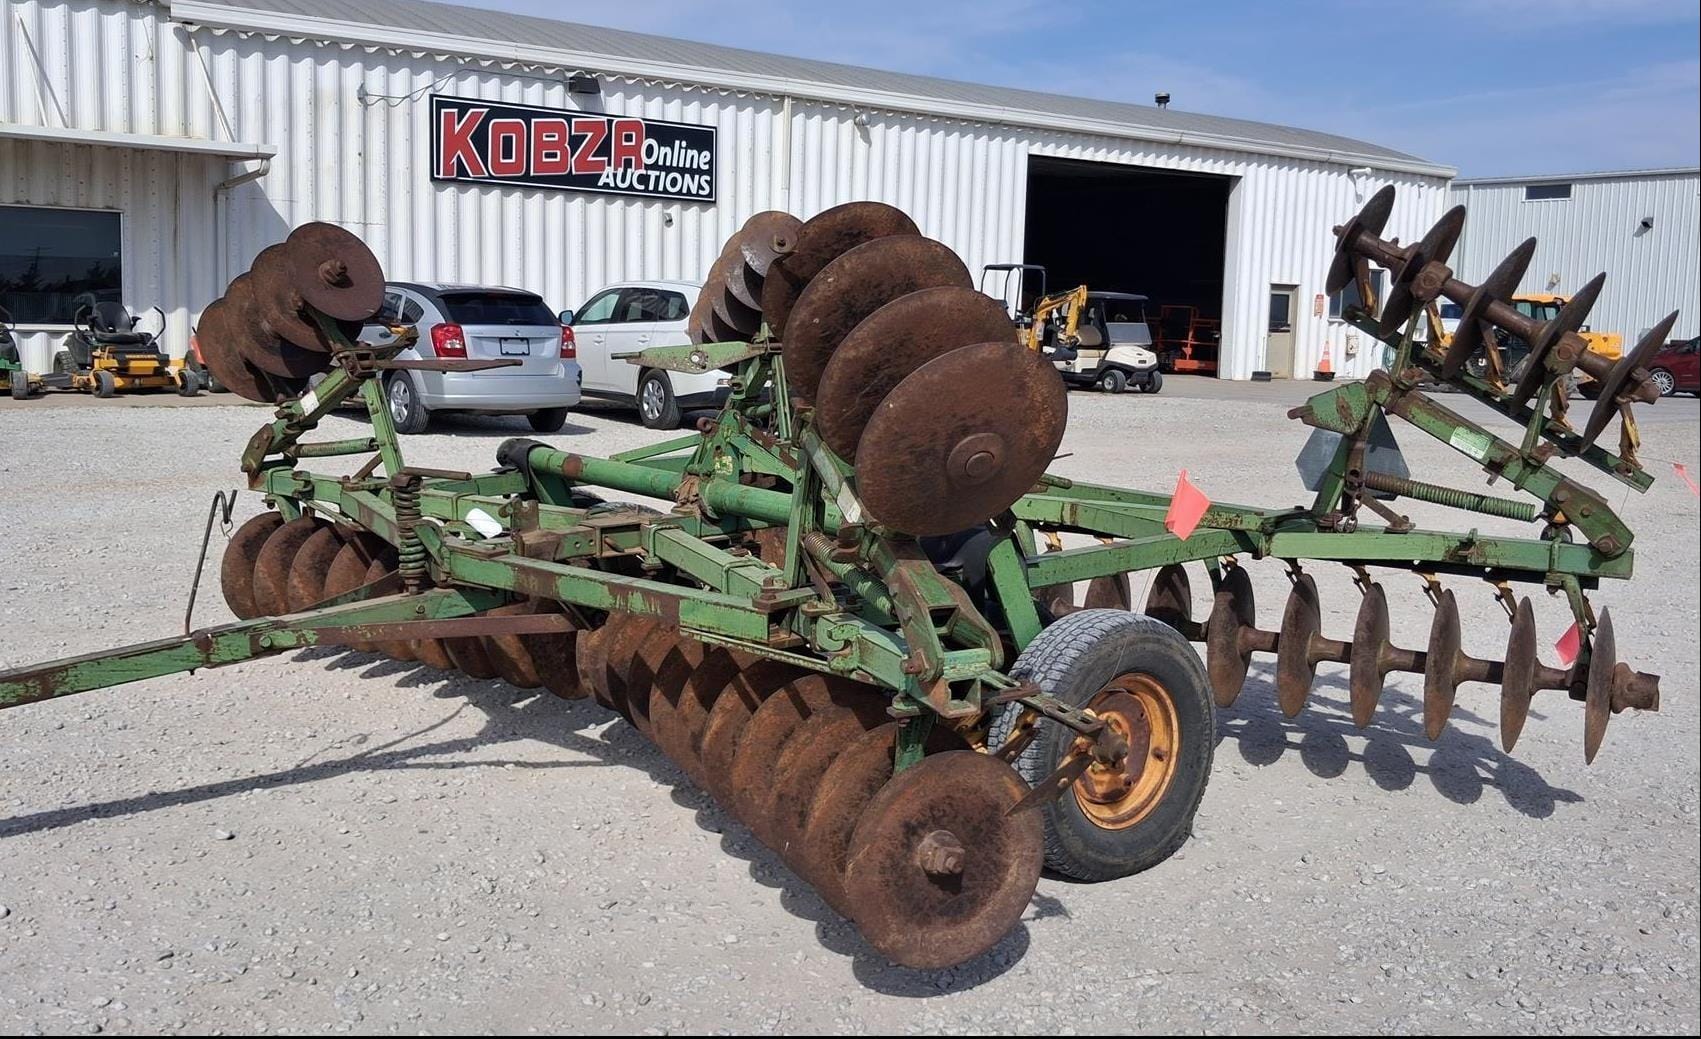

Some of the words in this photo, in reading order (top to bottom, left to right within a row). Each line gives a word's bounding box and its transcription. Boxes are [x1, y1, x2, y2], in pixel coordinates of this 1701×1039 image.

[440, 108, 645, 178] KOBZA
[641, 138, 711, 170] Online
[598, 166, 711, 195] AUCTIONS
